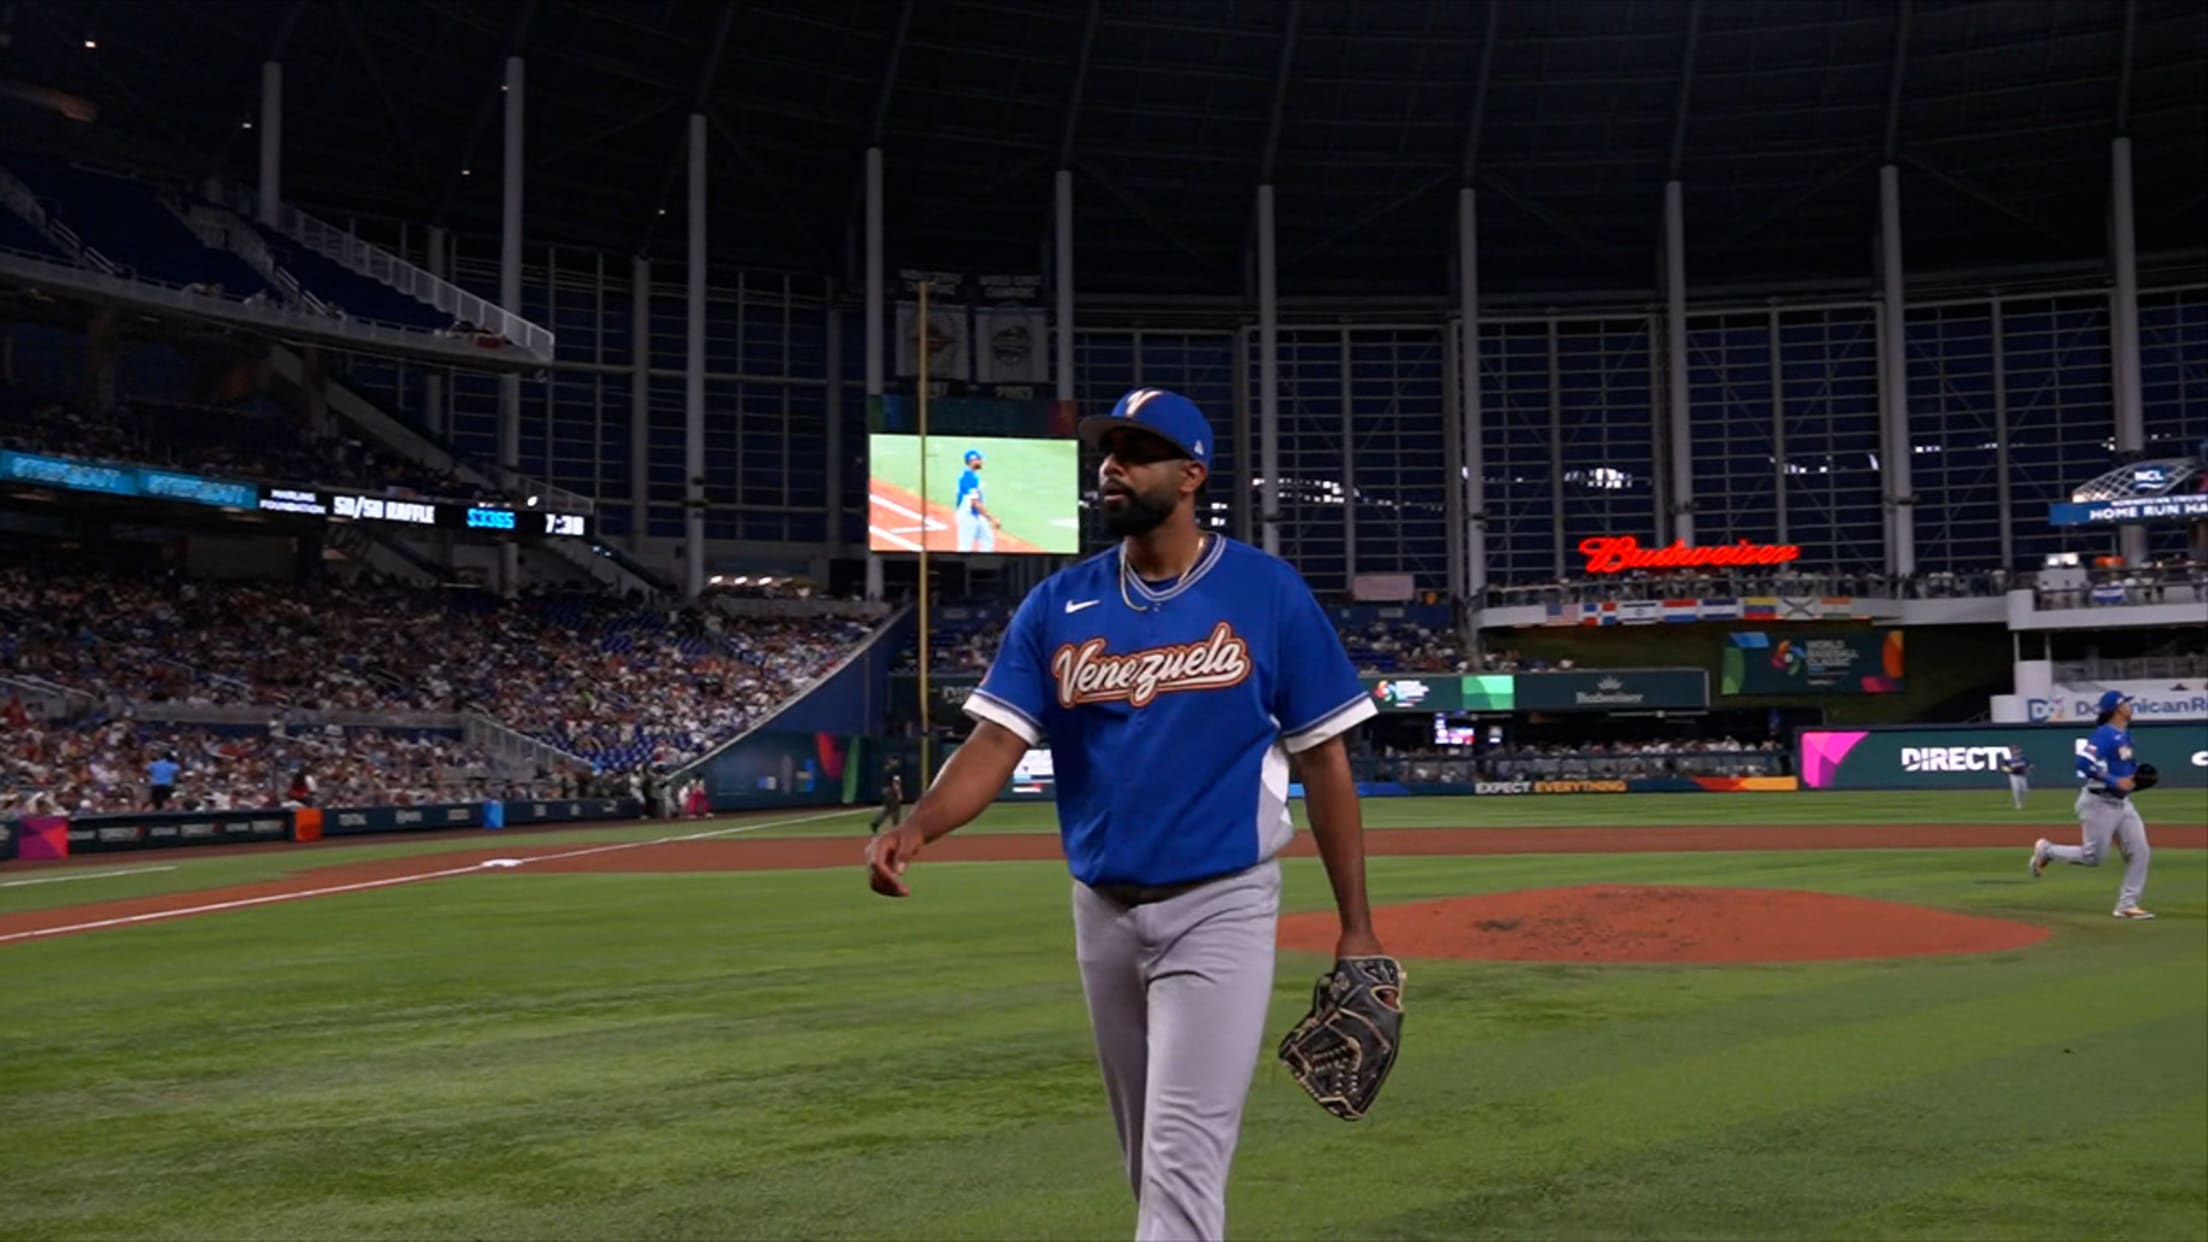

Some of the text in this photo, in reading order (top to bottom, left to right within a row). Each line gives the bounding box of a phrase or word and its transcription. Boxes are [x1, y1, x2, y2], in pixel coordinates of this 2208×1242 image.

[385, 501, 436, 524] RAFFLE
[2089, 507, 2138, 520] HOME
[2143, 503, 2180, 516] RUN
[1579, 535, 1799, 573] Budweiser
[1053, 621, 1250, 709] Venezuela
[1475, 780, 1628, 795] EXPECT EVERYTHING
